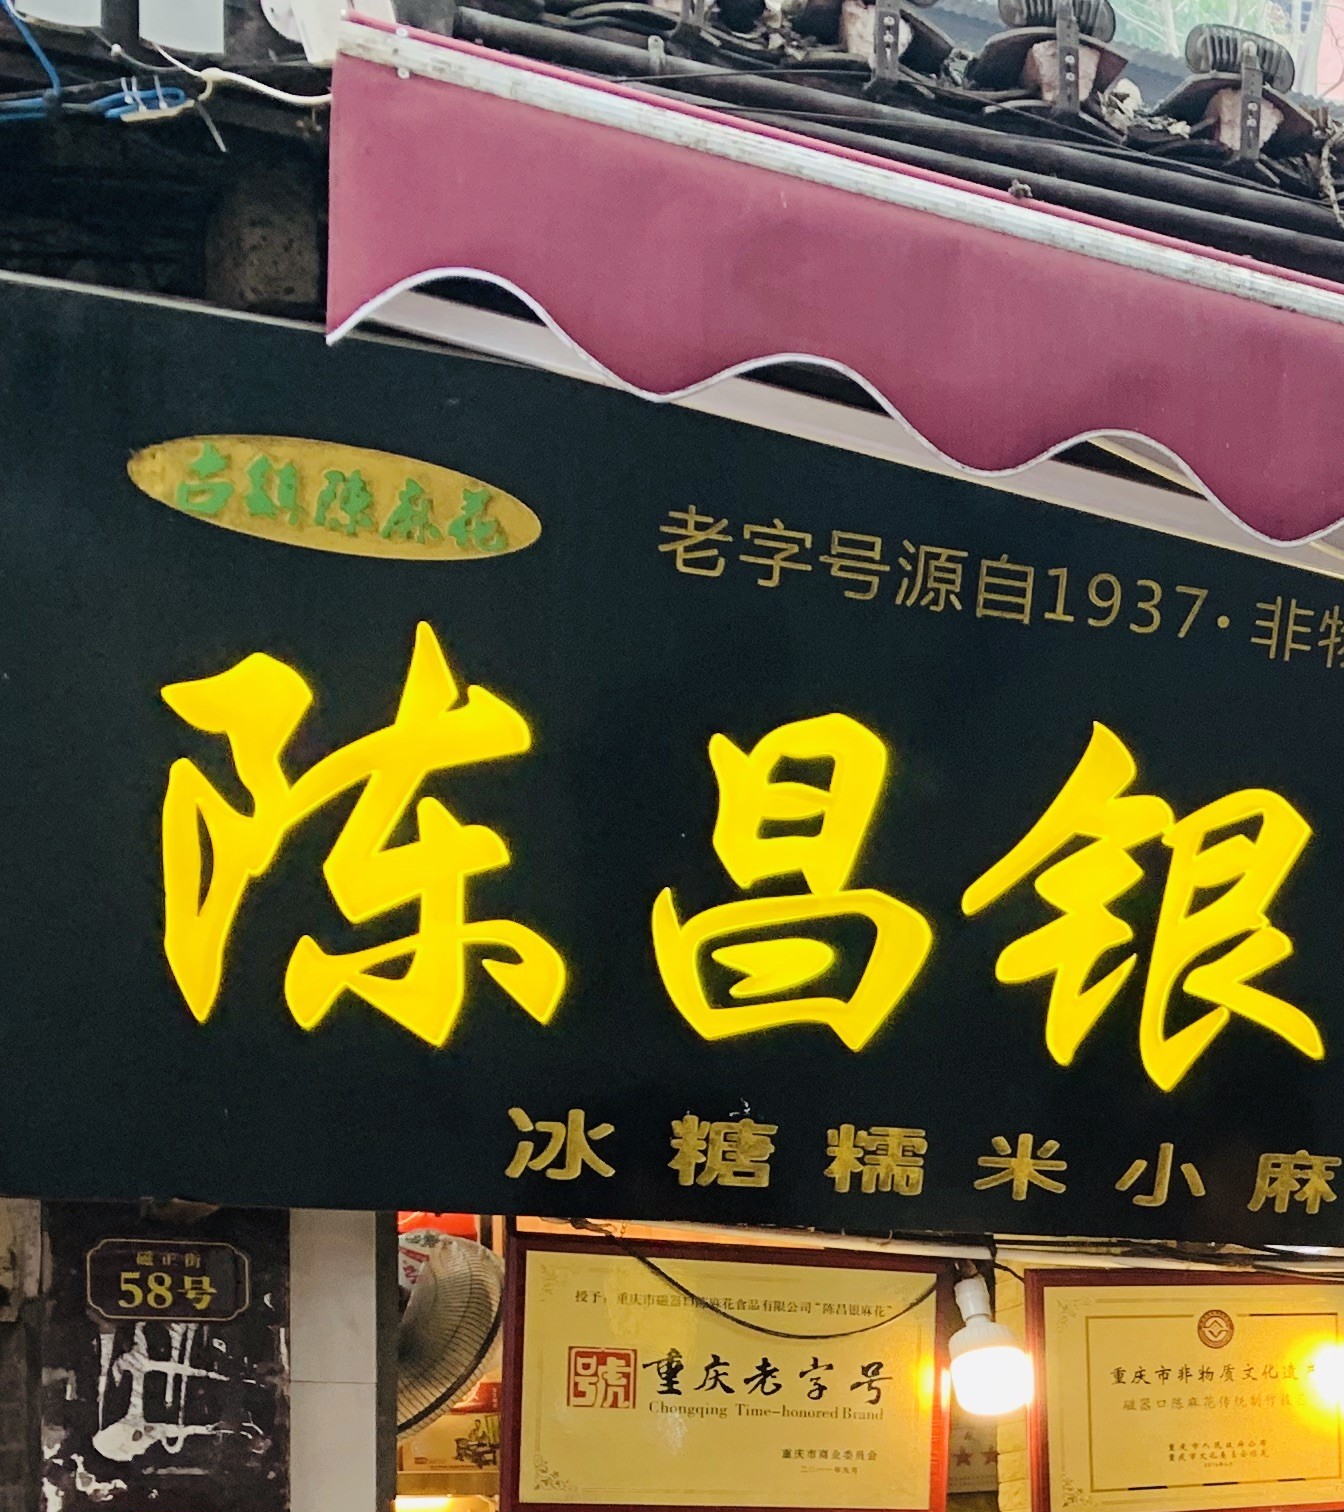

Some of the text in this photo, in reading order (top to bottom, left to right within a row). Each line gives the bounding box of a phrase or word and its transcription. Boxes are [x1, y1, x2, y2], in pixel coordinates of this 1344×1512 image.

[118, 1271, 217, 1310] 58号
[642, 1347, 894, 1405] 重庆老字号
[649, 1400, 728, 1420] Chongqing
[842, 1406, 884, 1421] Brand
